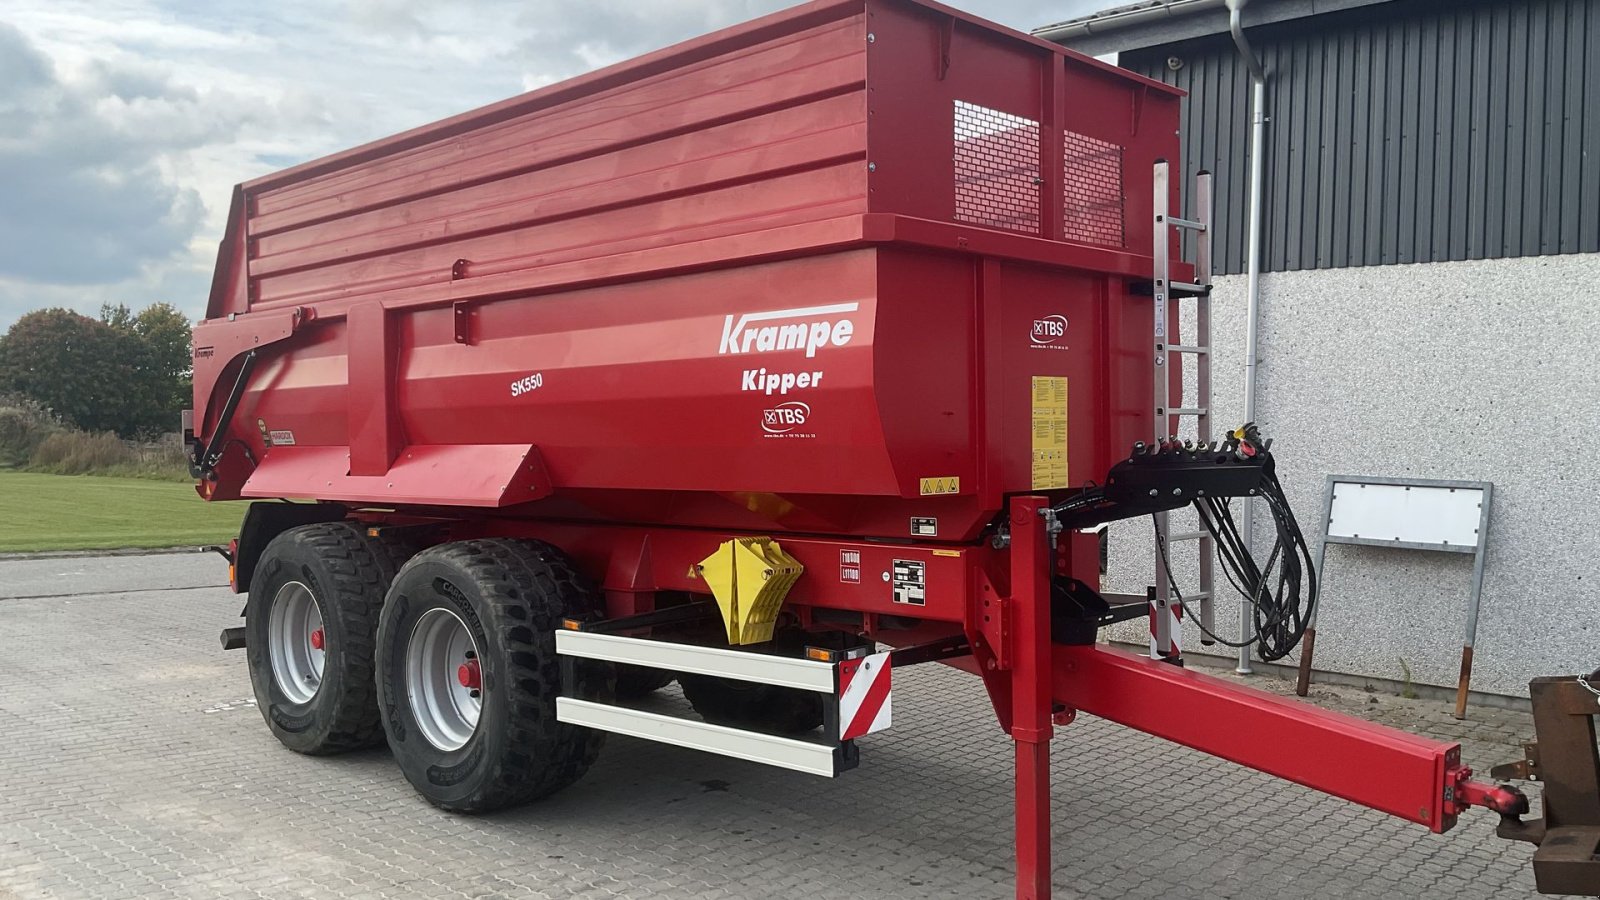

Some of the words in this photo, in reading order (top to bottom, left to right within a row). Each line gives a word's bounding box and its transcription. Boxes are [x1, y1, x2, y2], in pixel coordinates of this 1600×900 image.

[719, 303, 858, 357] Krampe
[1043, 320, 1063, 336] TBS
[511, 373, 542, 396] SK550
[742, 368, 823, 395] Kipper
[775, 408, 805, 424] TBS
